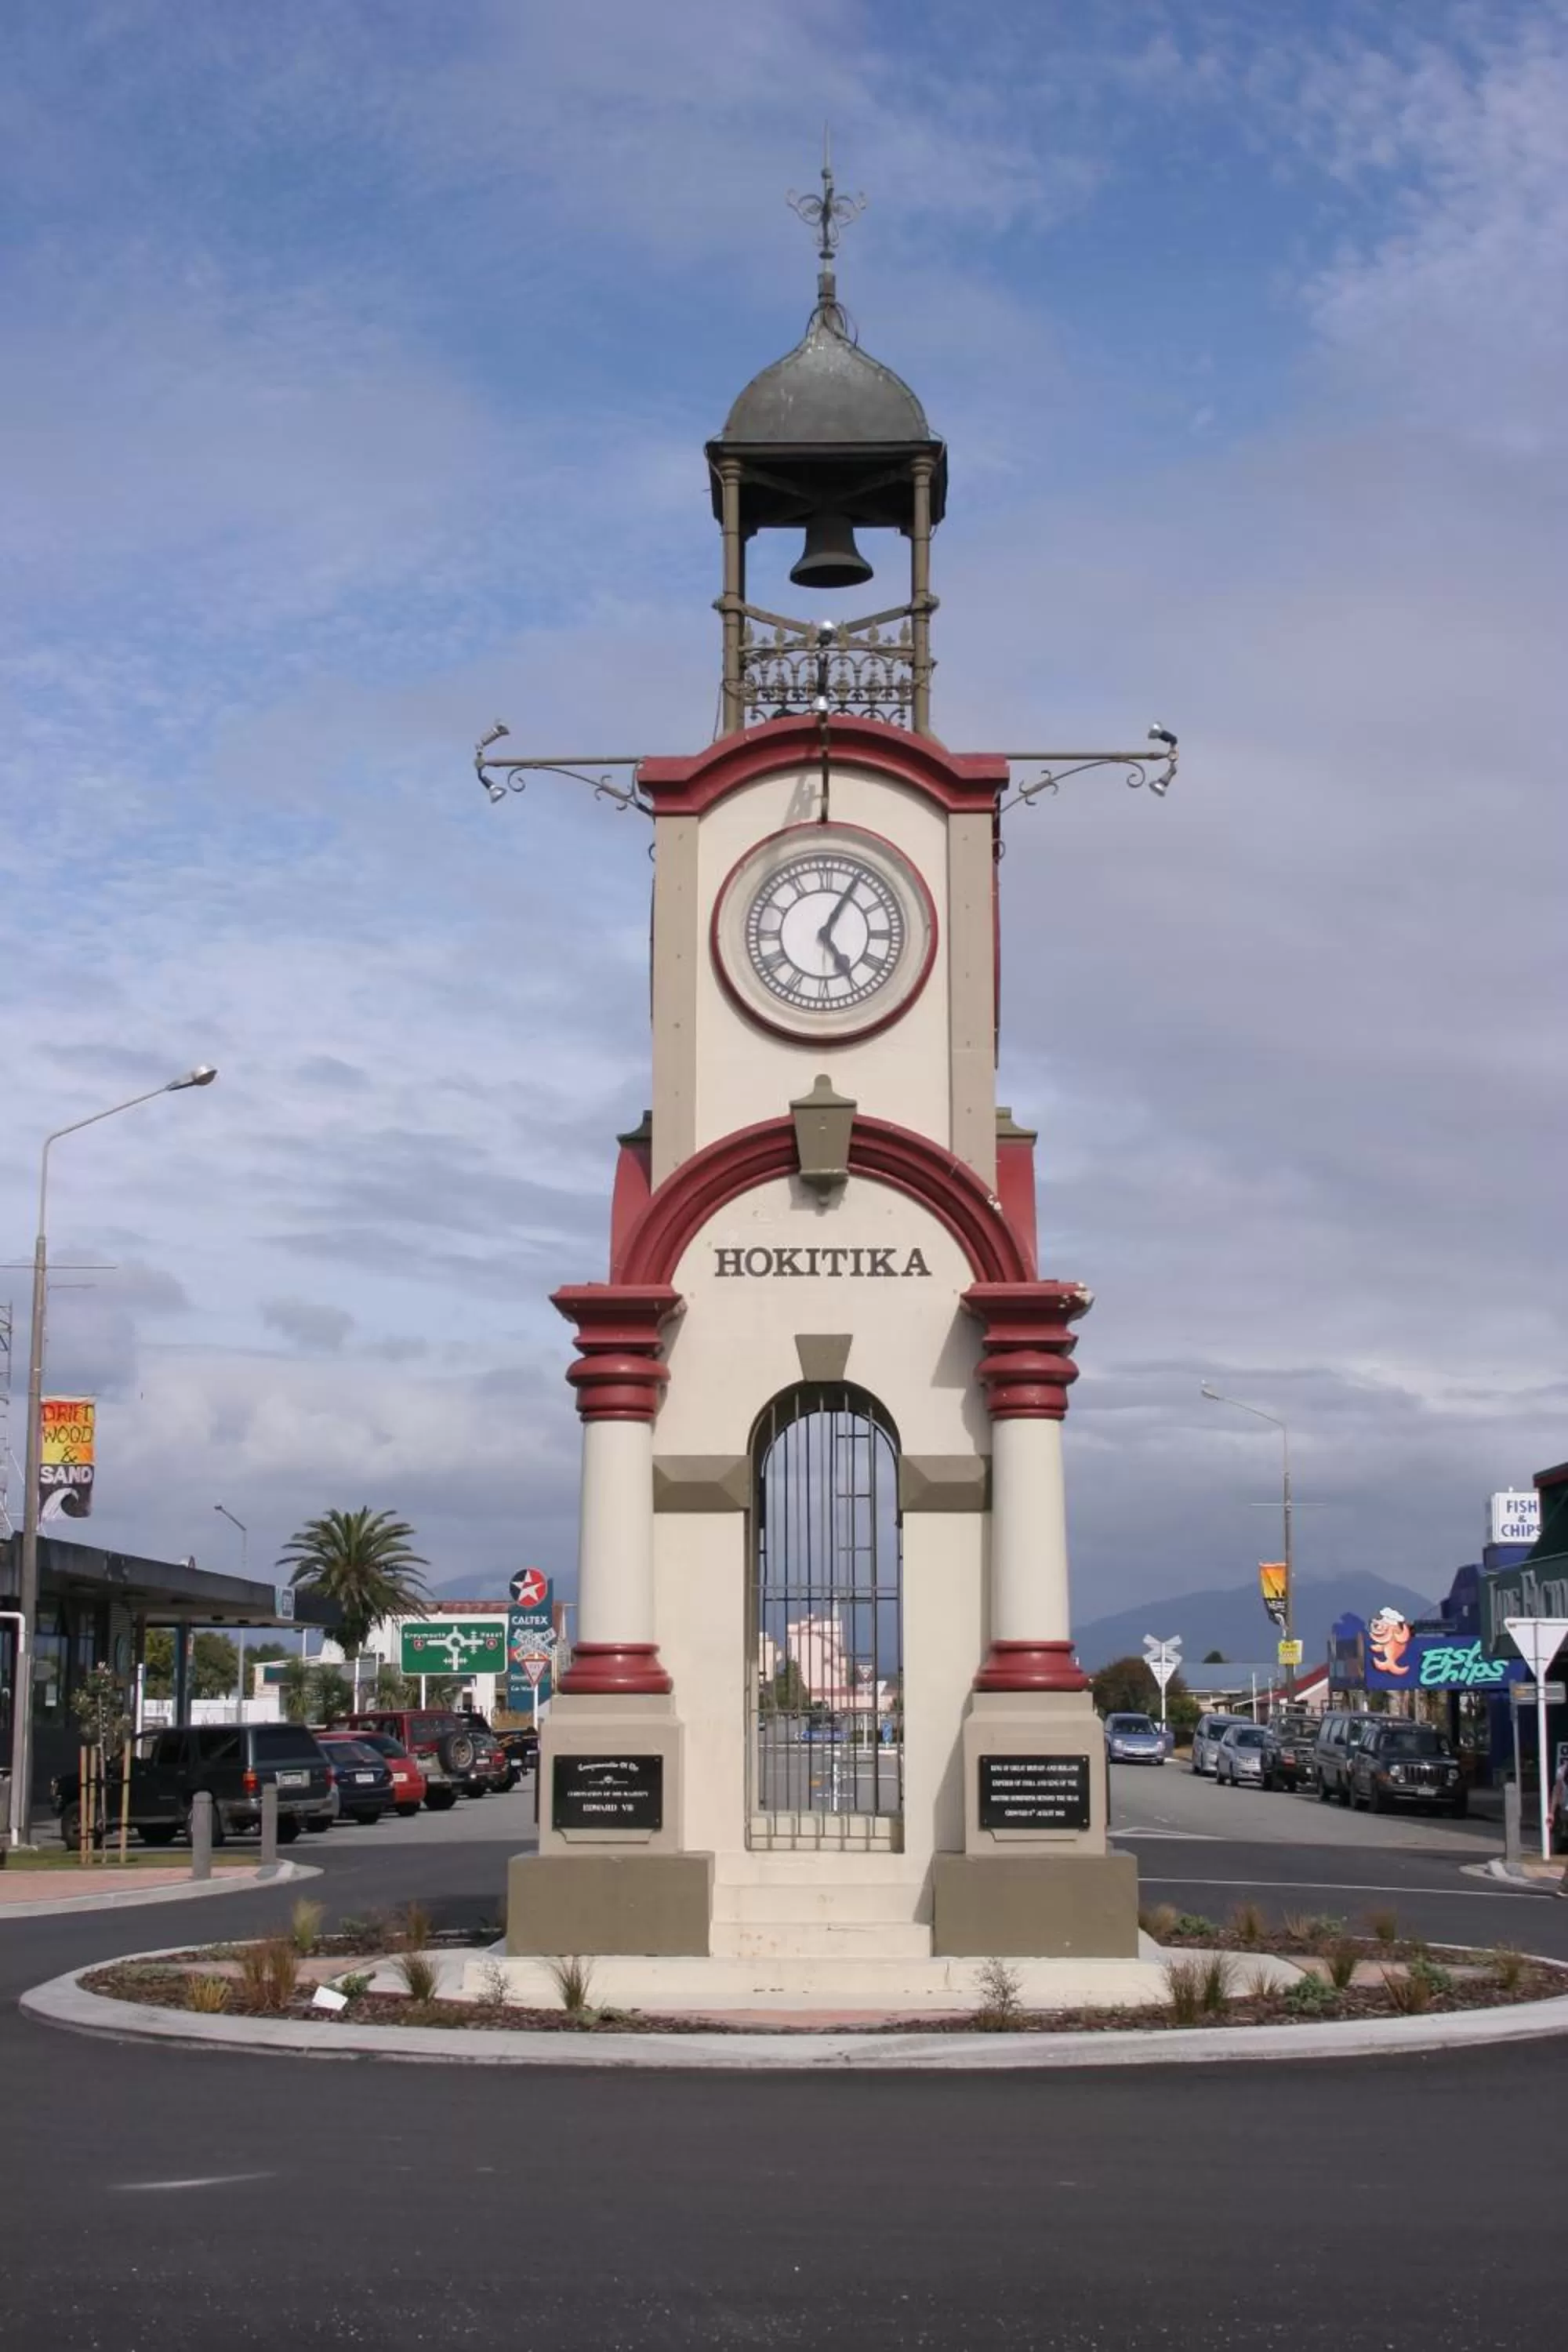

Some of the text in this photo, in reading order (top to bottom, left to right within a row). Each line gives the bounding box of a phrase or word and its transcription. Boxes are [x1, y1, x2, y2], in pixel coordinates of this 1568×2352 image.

[714, 1247, 931, 1277] HOKITIKA
[42, 1404, 95, 1422] DRIFT
[42, 1425, 93, 1443] WOOD
[60, 1445, 78, 1464] &
[40, 1466, 93, 1484] SAND
[1506, 1500, 1537, 1513] FISH
[1517, 1514, 1526, 1523] &
[511, 1616, 548, 1625] CALTEX
[1420, 1659, 1509, 1686] Chips
